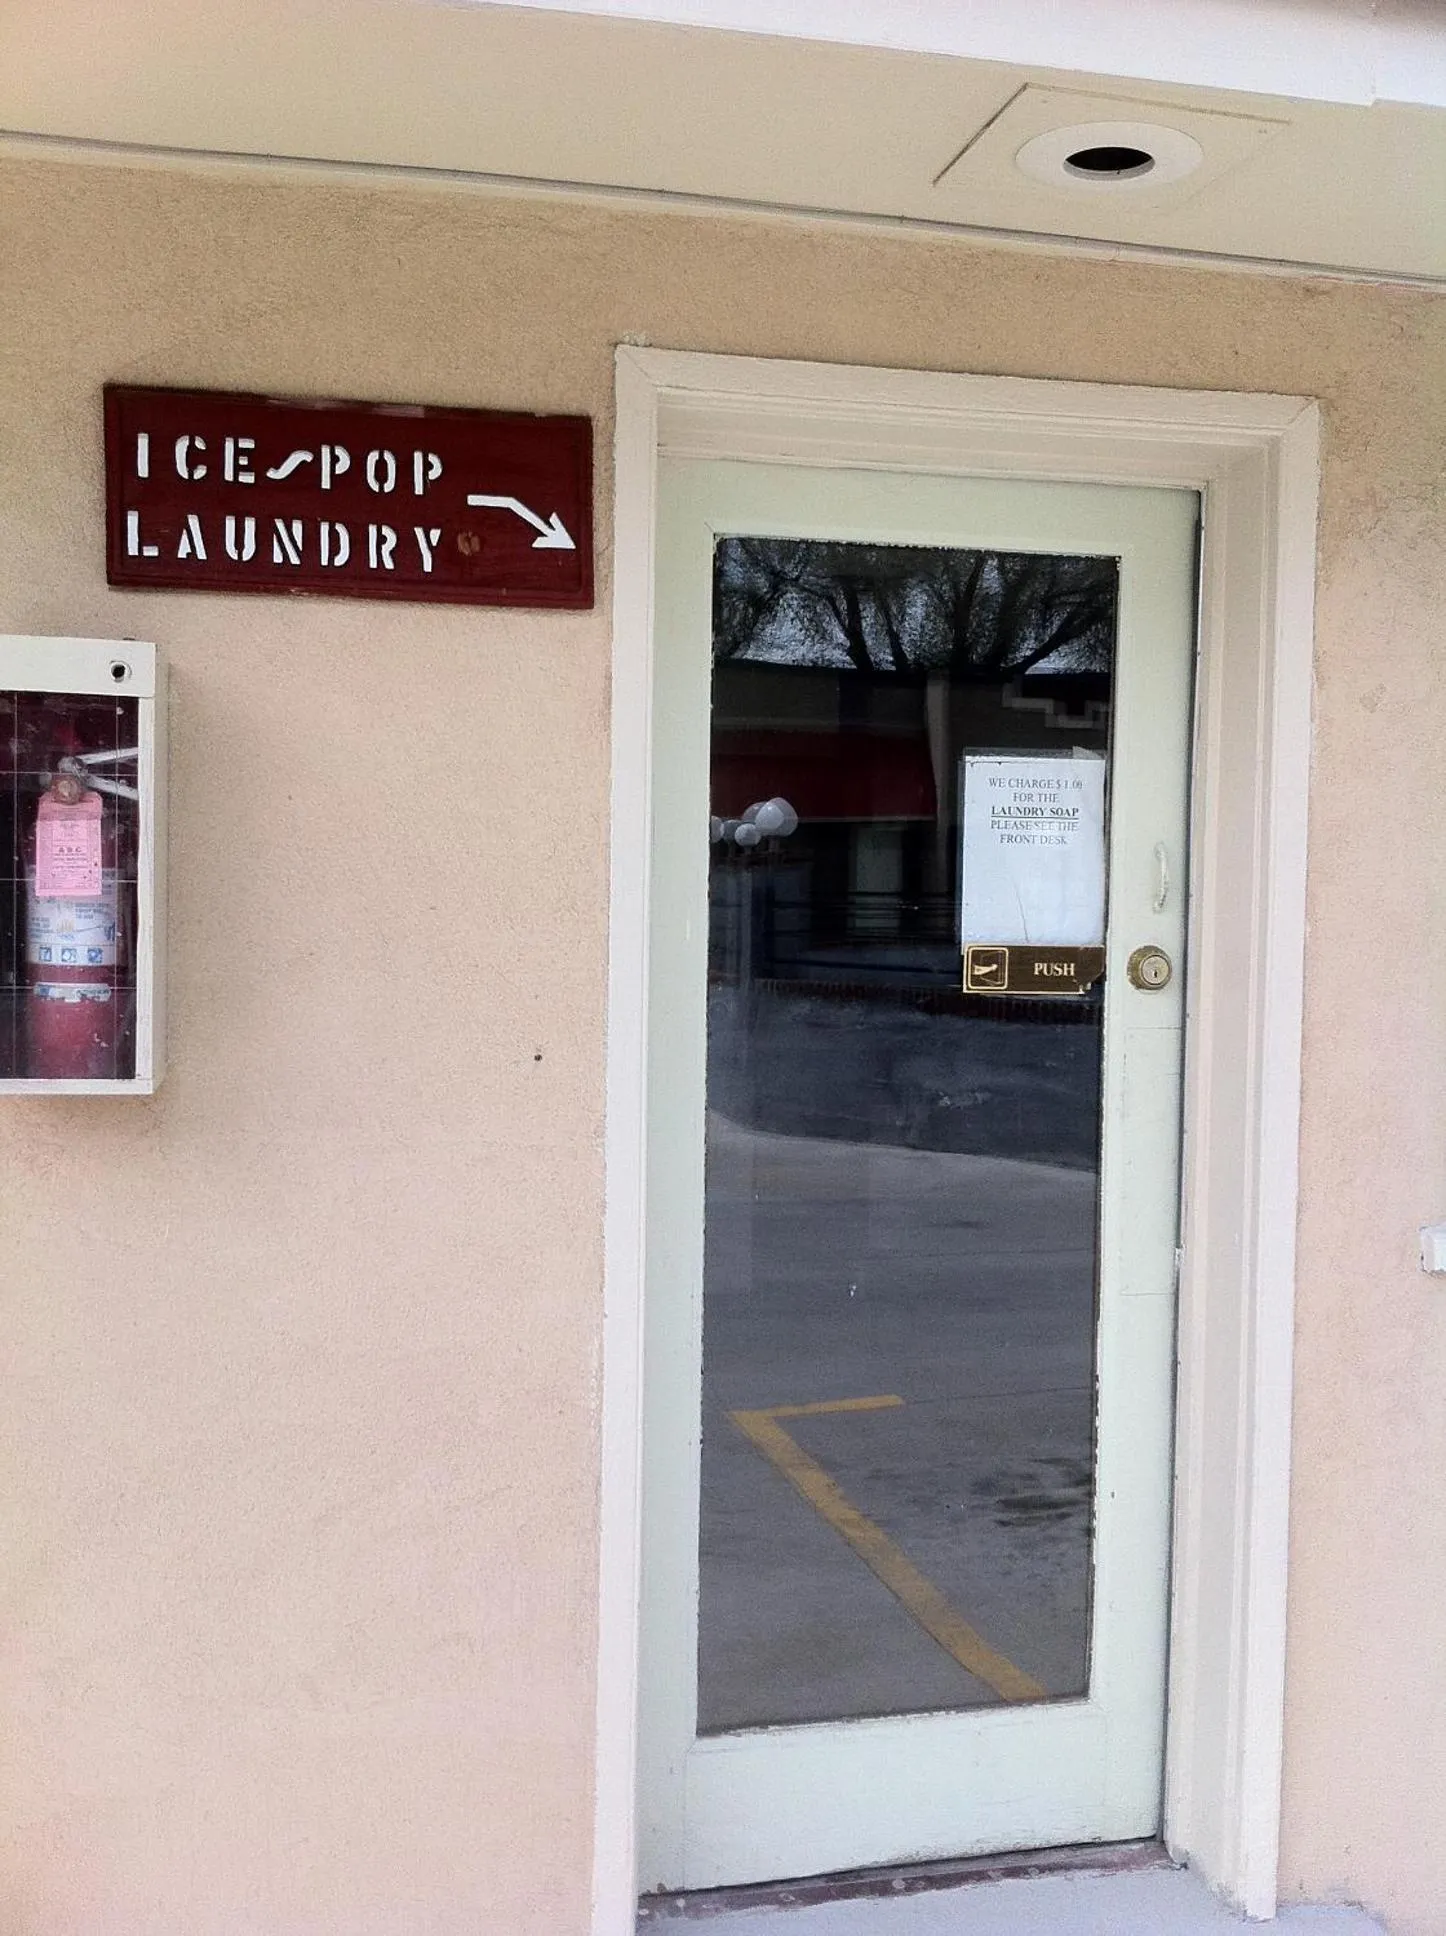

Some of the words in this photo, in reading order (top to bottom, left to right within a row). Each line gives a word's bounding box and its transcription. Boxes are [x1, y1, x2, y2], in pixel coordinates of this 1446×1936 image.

[127, 510, 441, 572] LAUNDRY
[989, 777, 1006, 789] WE
[1008, 778, 1055, 790] CHARGE
[1013, 792, 1035, 803] FOR
[1038, 793, 1059, 803] THE
[991, 805, 1046, 816] LAUNDRY
[1050, 807, 1079, 817] SOAP
[991, 819, 1033, 831] PLEASE
[1058, 821, 1079, 832] THE
[1000, 833, 1038, 844] FRONT
[1040, 834, 1068, 845] DESK
[1033, 962, 1076, 977] PUSH
